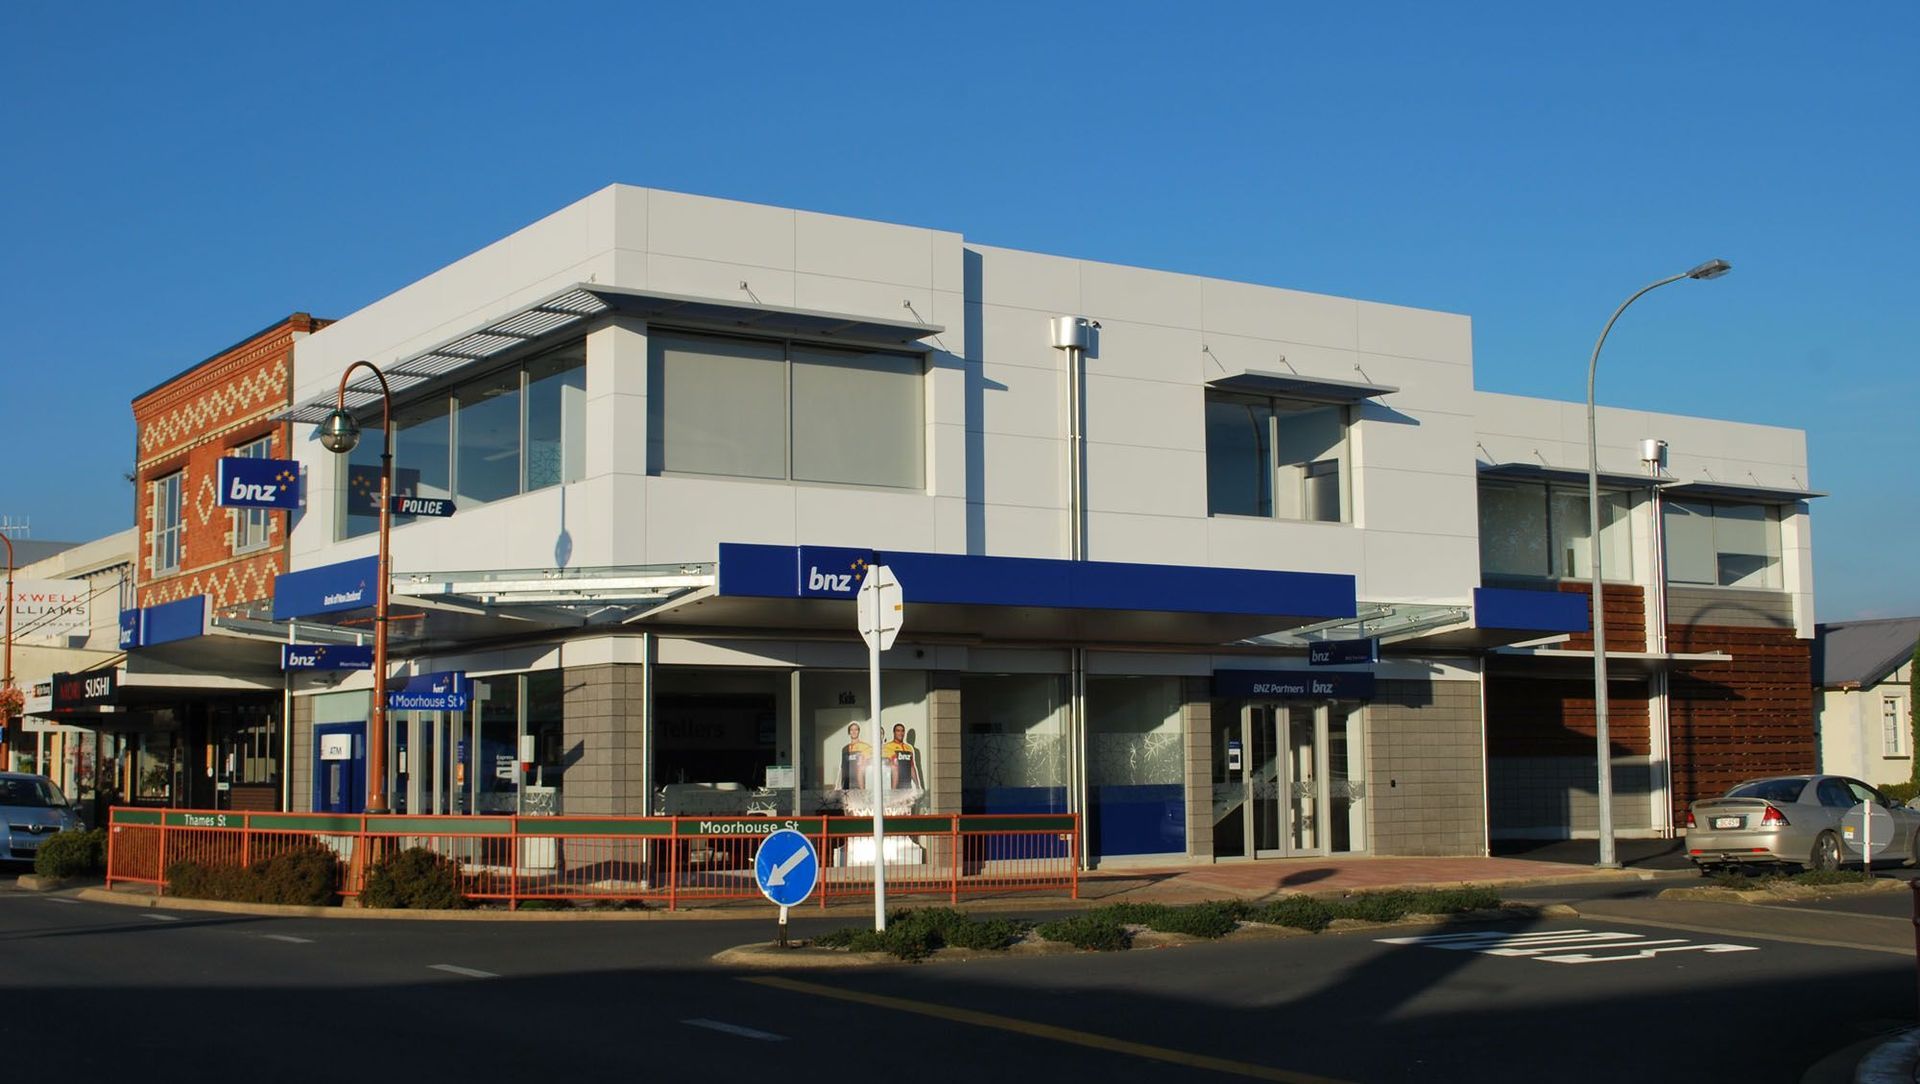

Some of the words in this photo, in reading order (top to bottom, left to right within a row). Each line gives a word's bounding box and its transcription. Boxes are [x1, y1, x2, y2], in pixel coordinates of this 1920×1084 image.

[230, 476, 277, 502] bnz
[402, 499, 443, 514] POLICE
[809, 566, 852, 592] bnz
[0, 605, 86, 615] LLIAMS
[289, 652, 316, 667] bnz
[1311, 650, 1330, 662] bnz
[84, 676, 110, 698] SUSHI
[1253, 683, 1270, 693] BNZ
[1270, 683, 1304, 693] Partners
[1312, 680, 1334, 693] bnz
[395, 695, 445, 708] Moorhouse
[447, 694, 458, 707] St
[897, 751, 911, 761] bnz
[184, 814, 215, 826] Thames
[217, 814, 226, 827] St
[700, 820, 778, 833] Moorhouse
[785, 820, 799, 830] St
